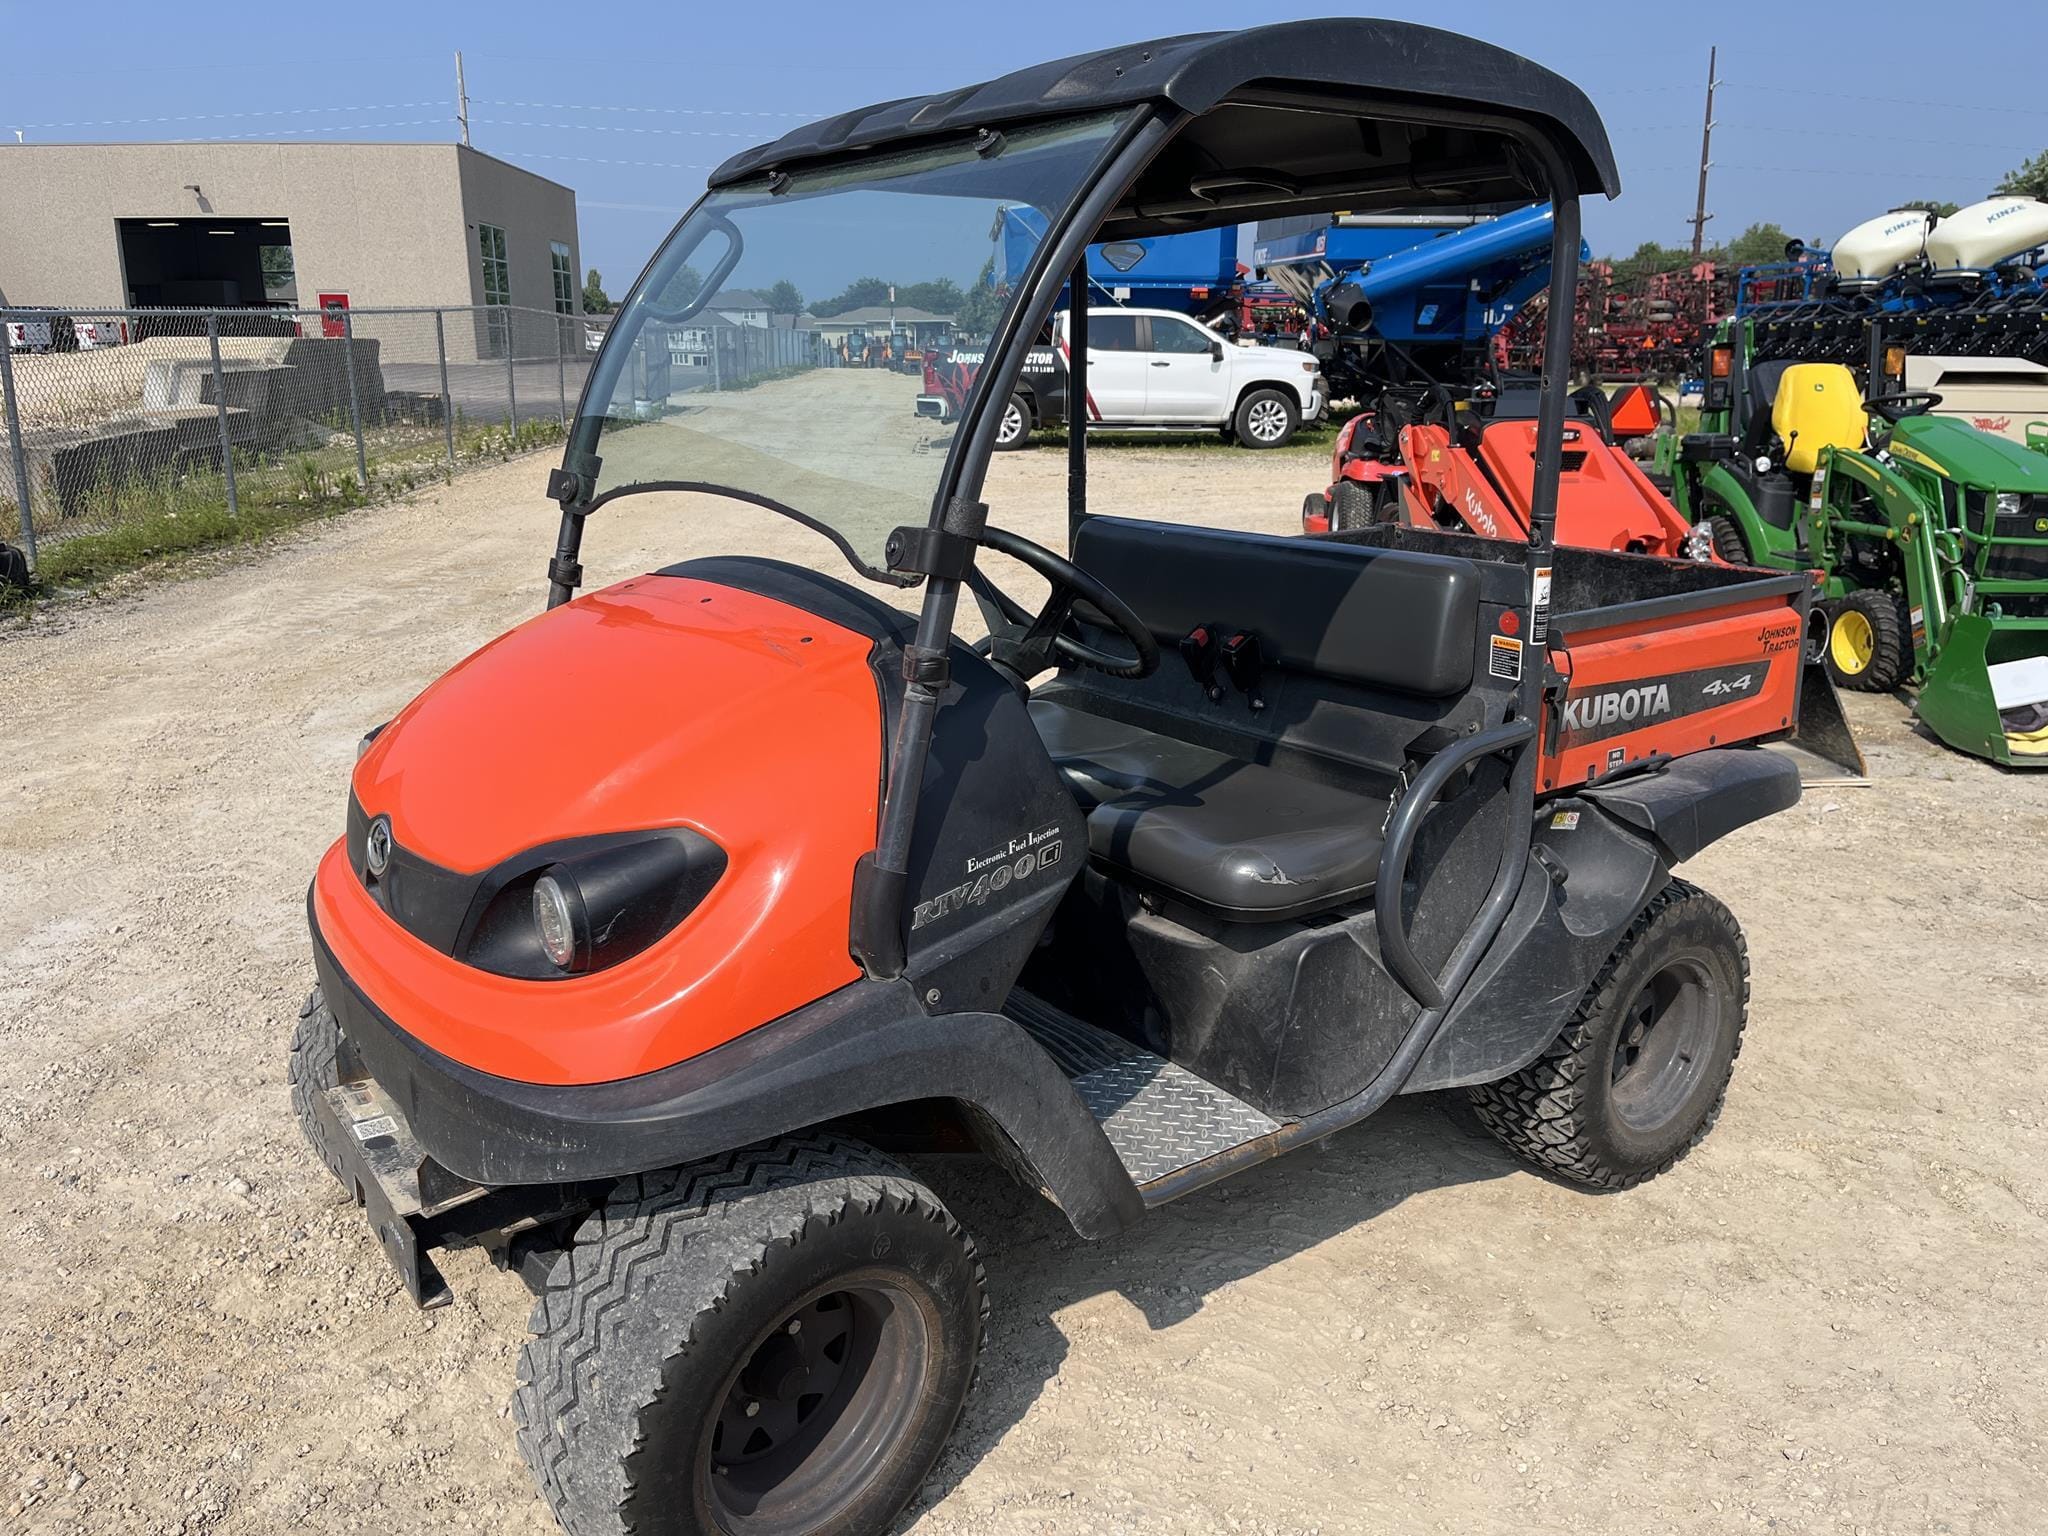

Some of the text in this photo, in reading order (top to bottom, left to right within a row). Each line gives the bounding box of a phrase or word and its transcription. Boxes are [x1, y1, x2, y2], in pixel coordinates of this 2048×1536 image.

[1987, 204, 2027, 224] KINZE
[1884, 218, 1921, 236] KINZE
[946, 349, 1054, 364] JOHNS CTOR
[1465, 487, 1497, 537] Kubota
[1757, 625, 1797, 642] JOHNSON
[1763, 638, 1800, 654] TRACTOR
[1561, 674, 1752, 732] KUBOTA 4x4
[1608, 759, 1623, 768] STEP
[1612, 751, 1621, 759] NO
[967, 826, 1060, 874] Electronic Fuel Injection
